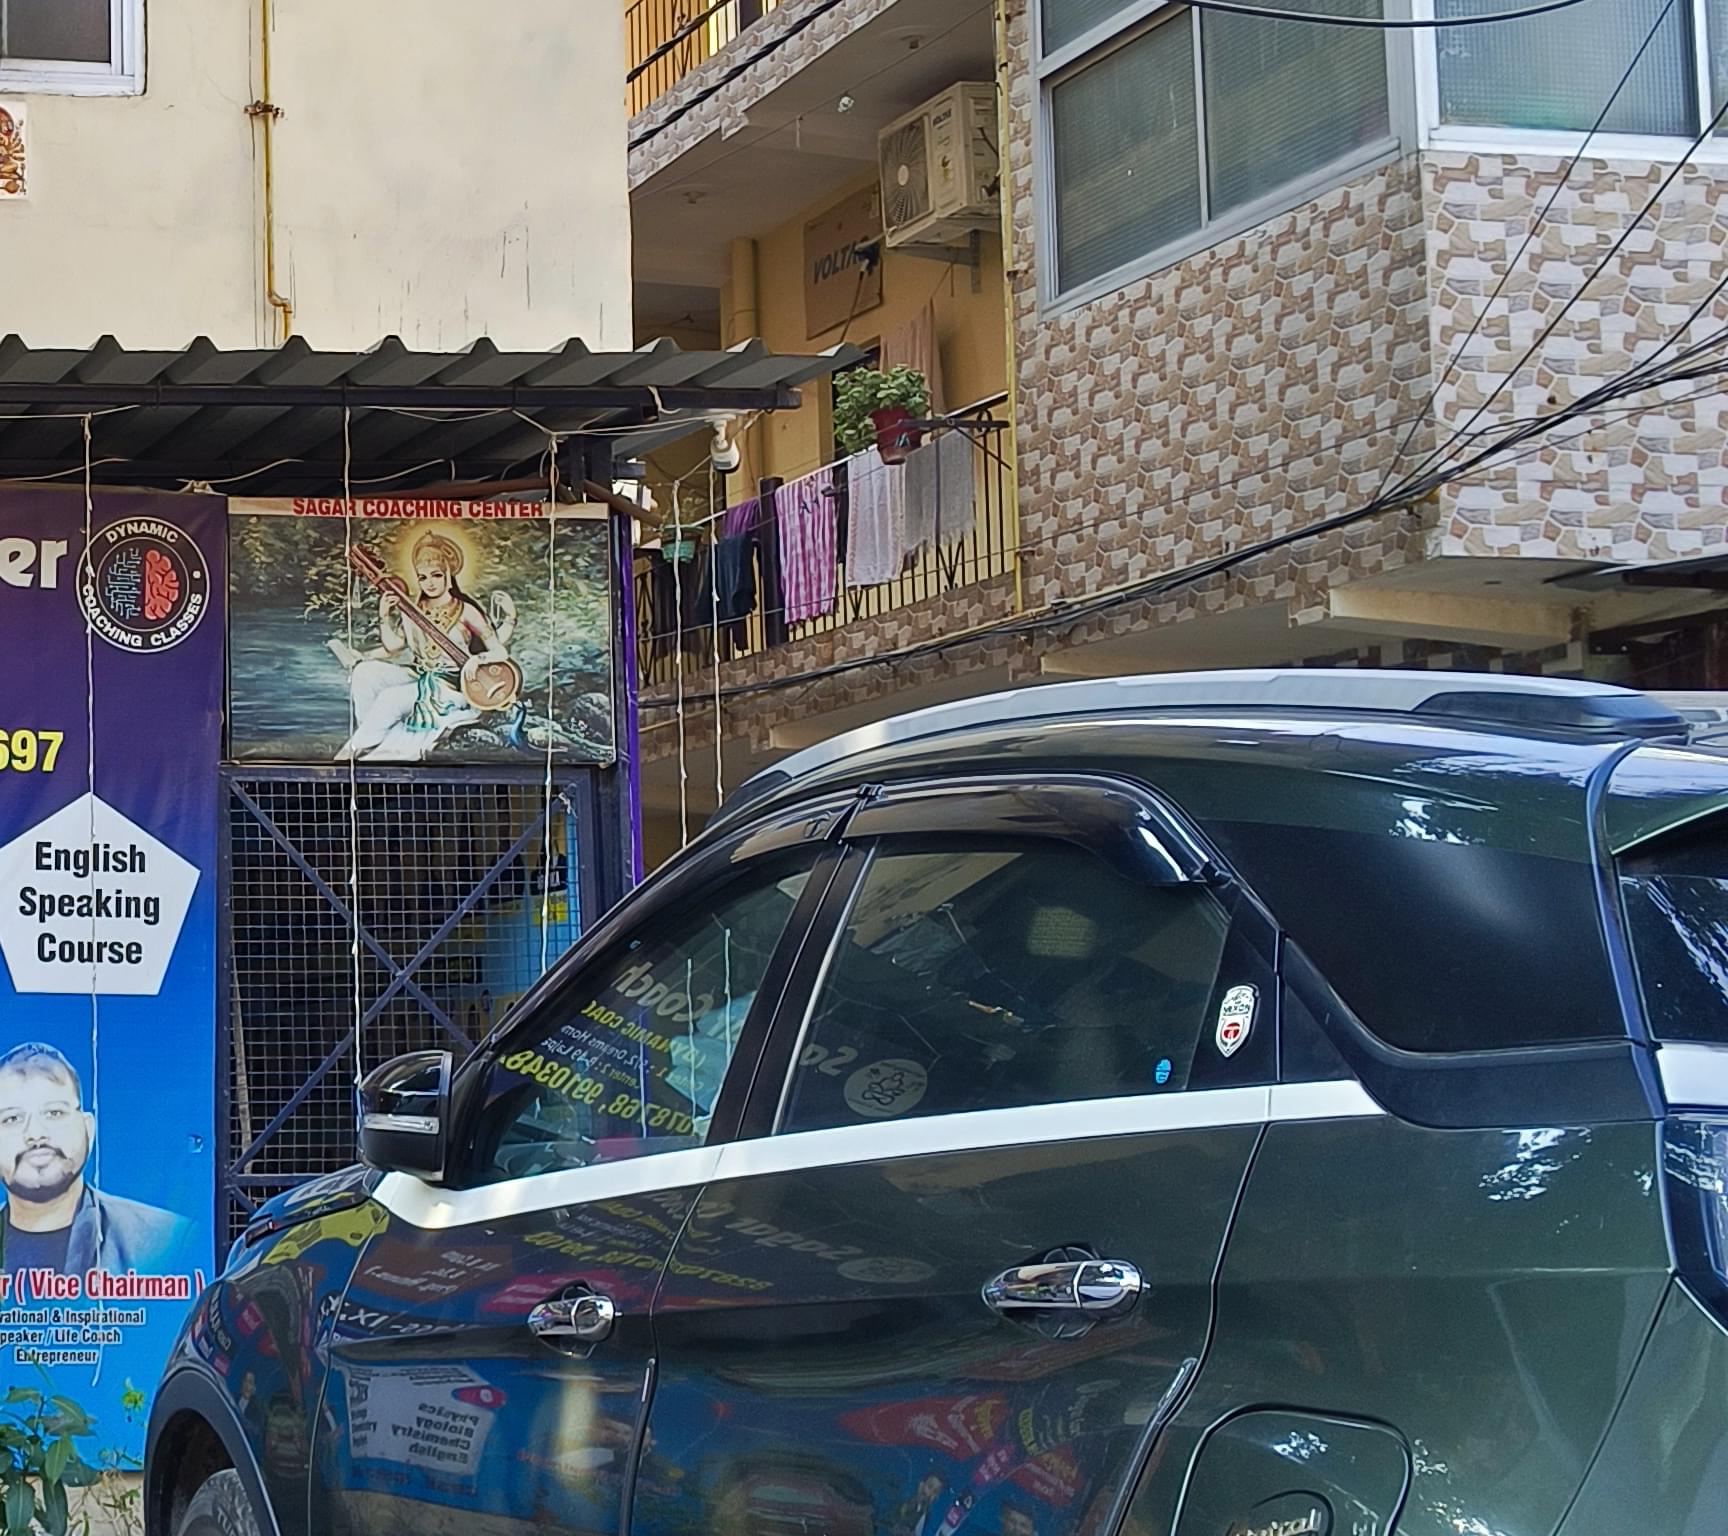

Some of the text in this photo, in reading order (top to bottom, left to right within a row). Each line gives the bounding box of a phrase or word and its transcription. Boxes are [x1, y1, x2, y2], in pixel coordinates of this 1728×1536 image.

[293, 497, 543, 518] SAGAR COACHING CENTER
[105, 522, 178, 543] DYNAMIC
[82, 583, 203, 646] COACHING CLASSES
[34, 841, 147, 878] English
[18, 886, 161, 926] Speaking
[37, 932, 143, 965] Course
[28, 1268, 80, 1299] Vice
[85, 1267, 189, 1300] Chairman
[54, 1328, 78, 1344] Life
[80, 1328, 121, 1344] Coach
[15, 1348, 99, 1366] Entrepreneur
